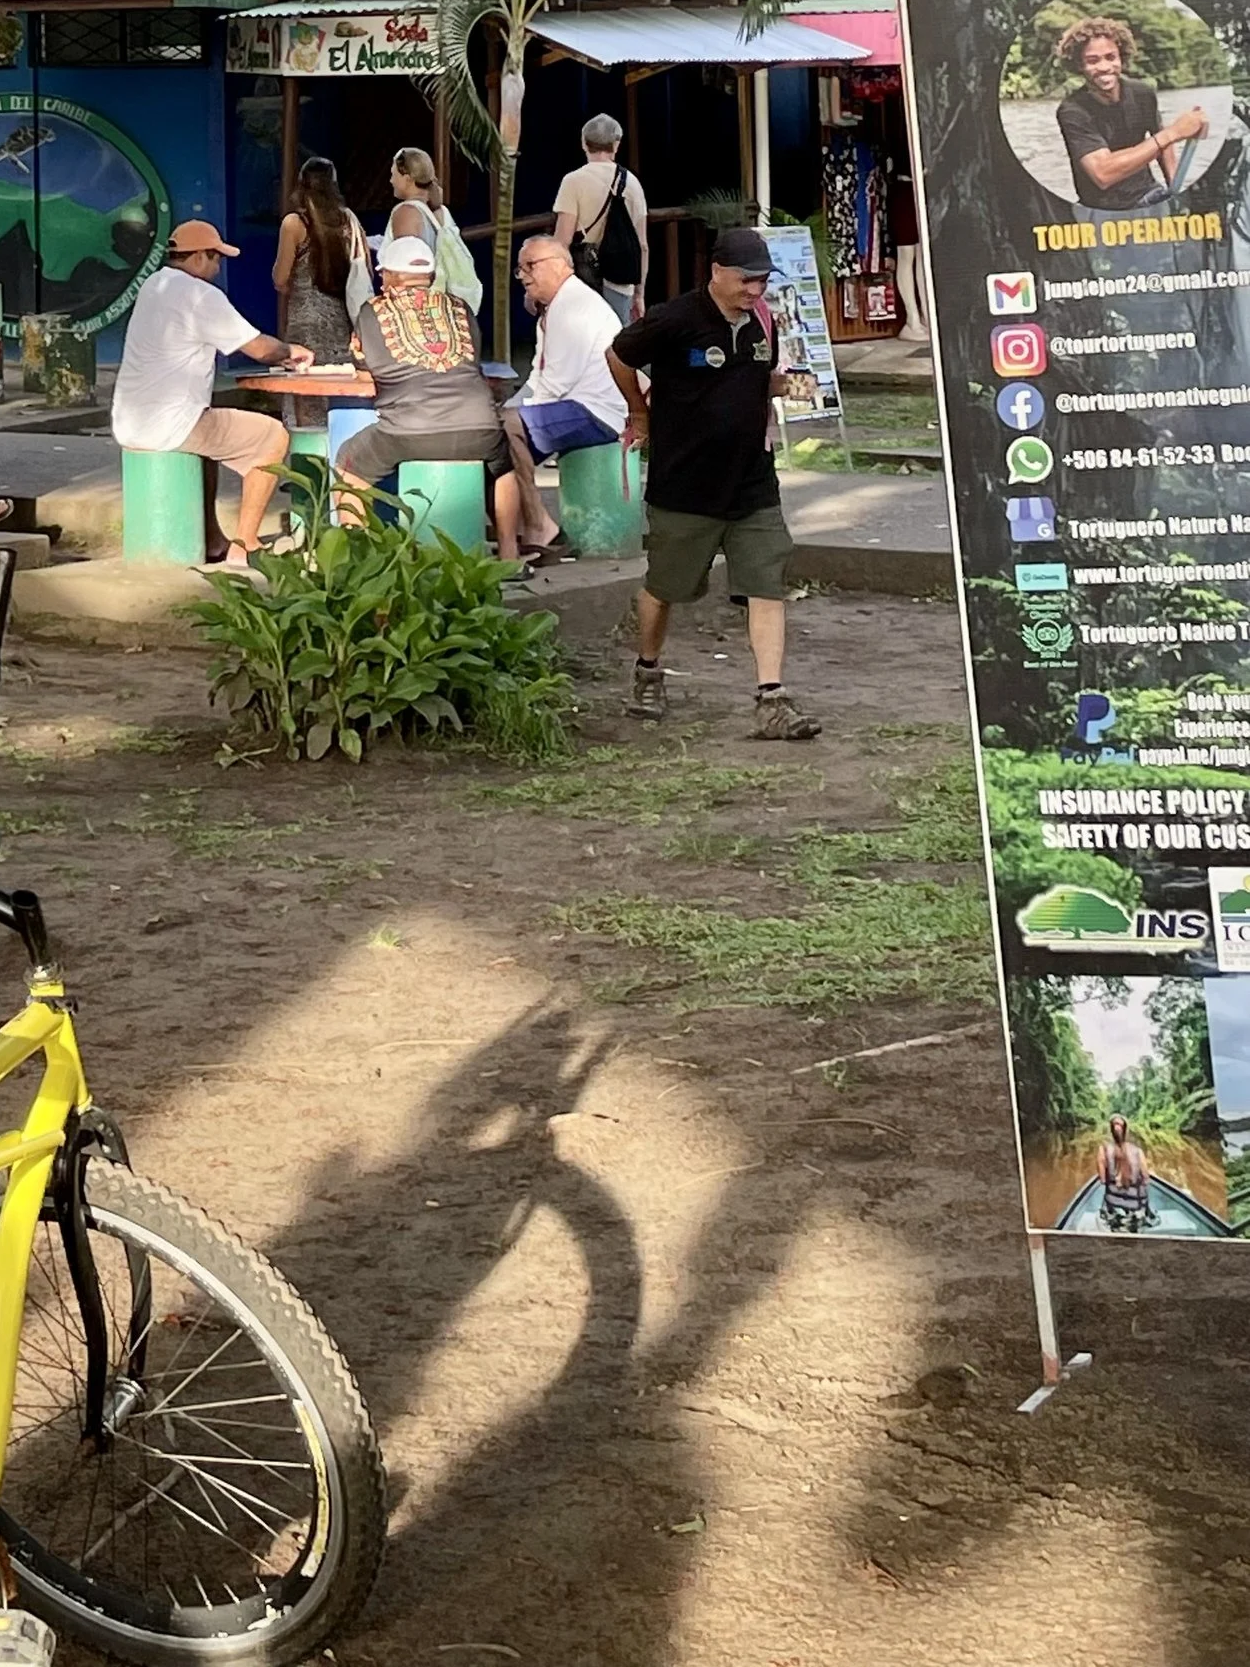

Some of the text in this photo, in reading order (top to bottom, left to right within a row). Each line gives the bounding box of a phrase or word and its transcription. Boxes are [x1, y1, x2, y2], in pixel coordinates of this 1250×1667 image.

[385, 14, 428, 42] Soda
[329, 40, 352, 73] El
[1033, 211, 1223, 252] TOUR OPERATOR
[1050, 332, 1196, 356] @tourtortuguero
[1062, 448, 1108, 470] +506
[1109, 444, 1215, 468] 84-61-52-33
[1068, 519, 1166, 539] Tortuguero
[1168, 516, 1228, 535] Nature
[1079, 623, 1178, 645] Tortuguero
[1179, 622, 1236, 642] Native
[1187, 691, 1223, 711] Book
[1038, 789, 1246, 815] INSURANCE POLICY
[1041, 824, 1119, 849] SAFETY
[1123, 824, 1151, 849] OF
[1153, 824, 1202, 849] OUR
[1136, 914, 1207, 939] INS
